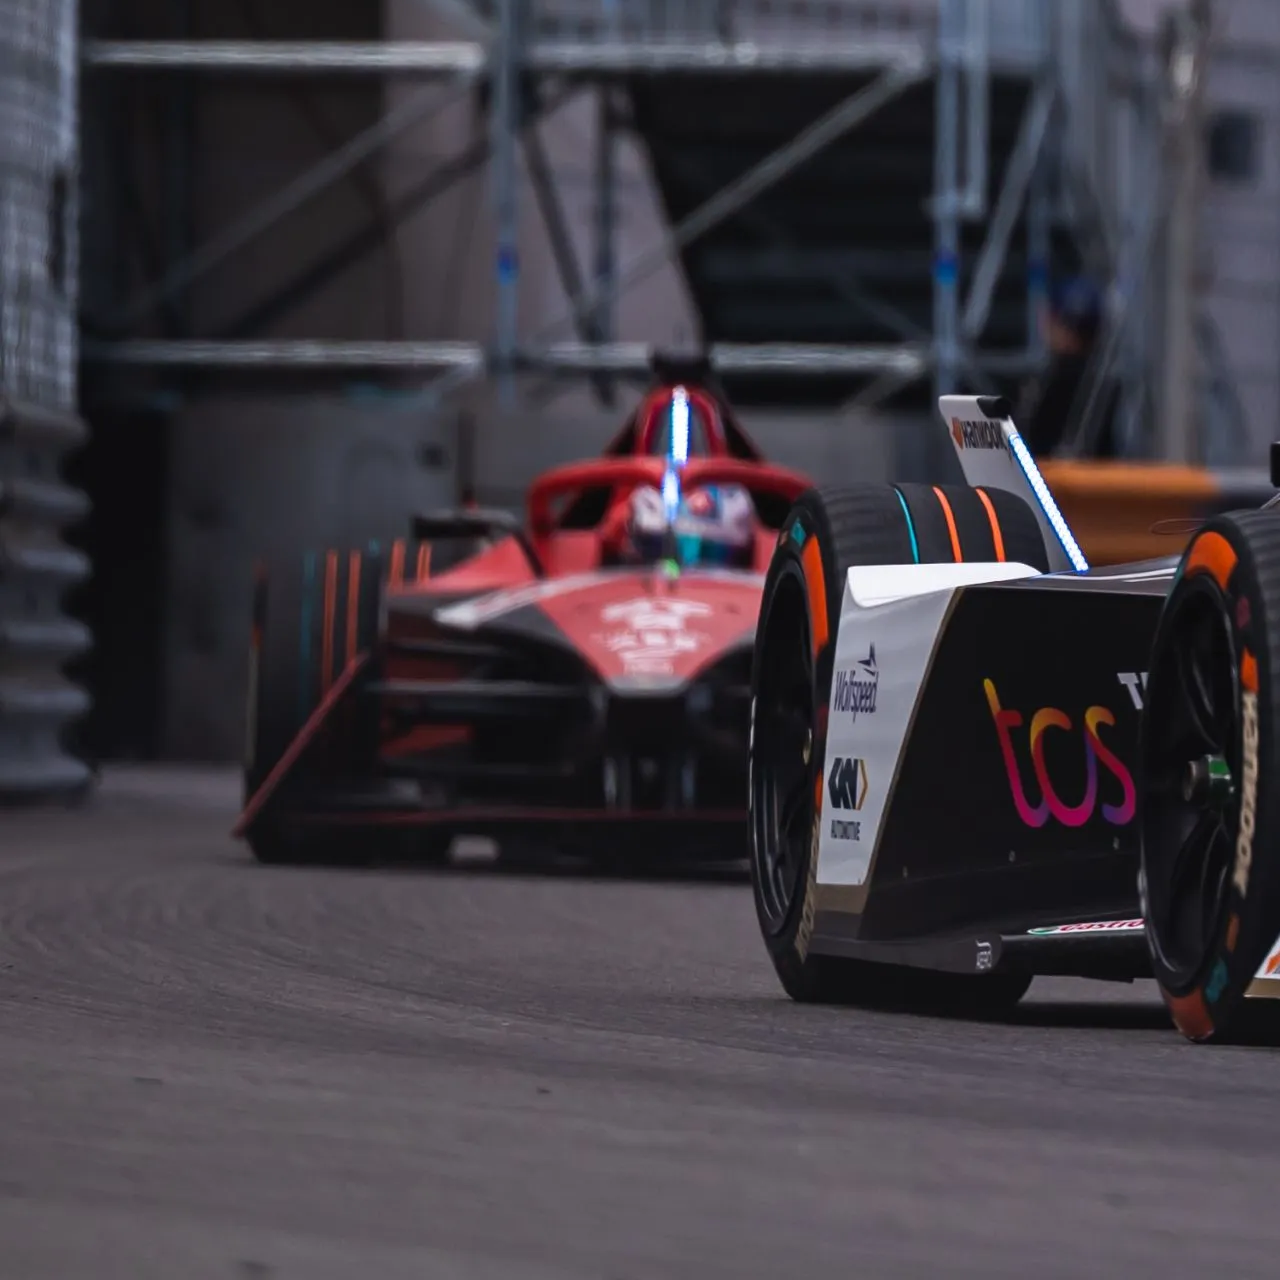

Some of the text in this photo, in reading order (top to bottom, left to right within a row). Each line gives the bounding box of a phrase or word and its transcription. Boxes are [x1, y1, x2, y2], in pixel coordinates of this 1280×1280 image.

[834, 670, 879, 724] Wolfspeed
[1116, 672, 1149, 710] T
[983, 677, 1137, 828] tcs
[1058, 918, 1145, 933] Castro
